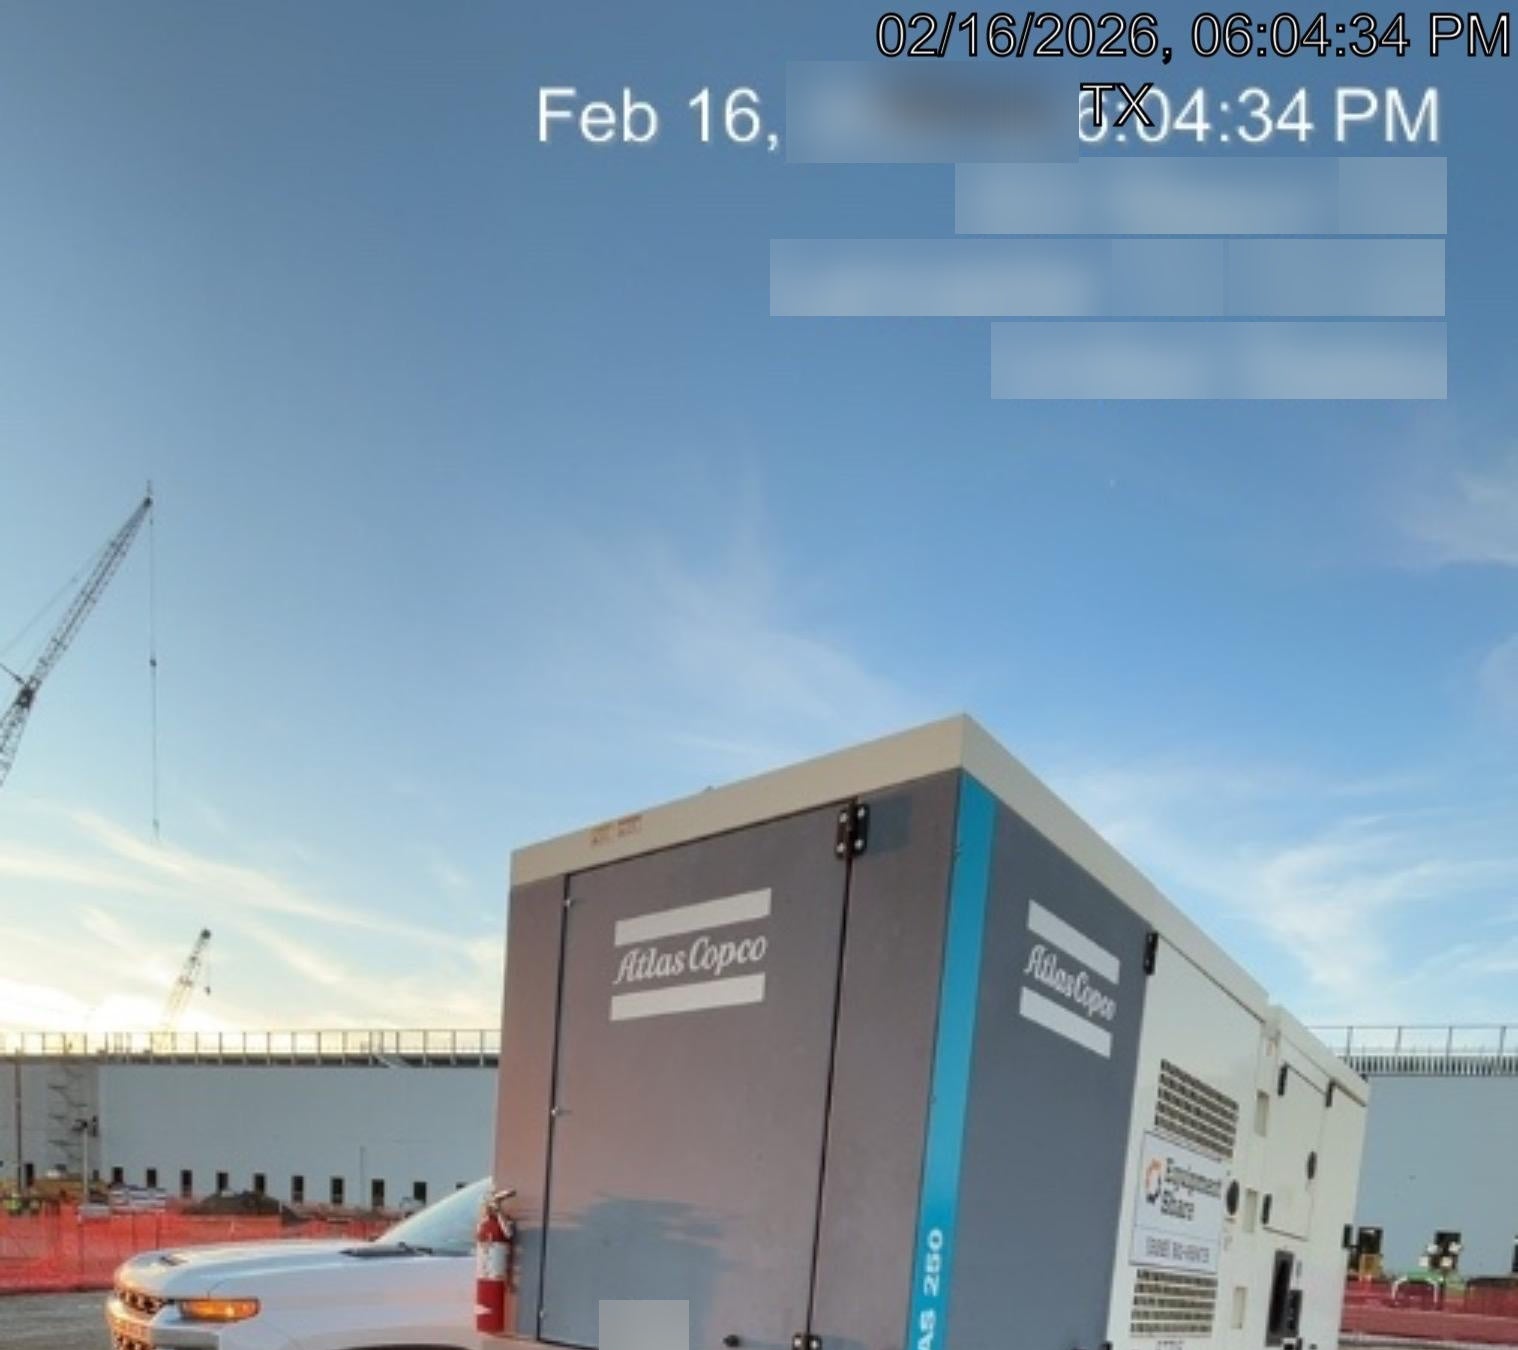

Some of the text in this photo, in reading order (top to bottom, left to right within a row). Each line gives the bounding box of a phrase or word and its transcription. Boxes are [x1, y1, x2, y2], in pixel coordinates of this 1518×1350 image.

[612, 935, 769, 985] Atlas Copco
[1023, 943, 1117, 1021] Atlas Copco
[923, 1228, 944, 1297] 250
